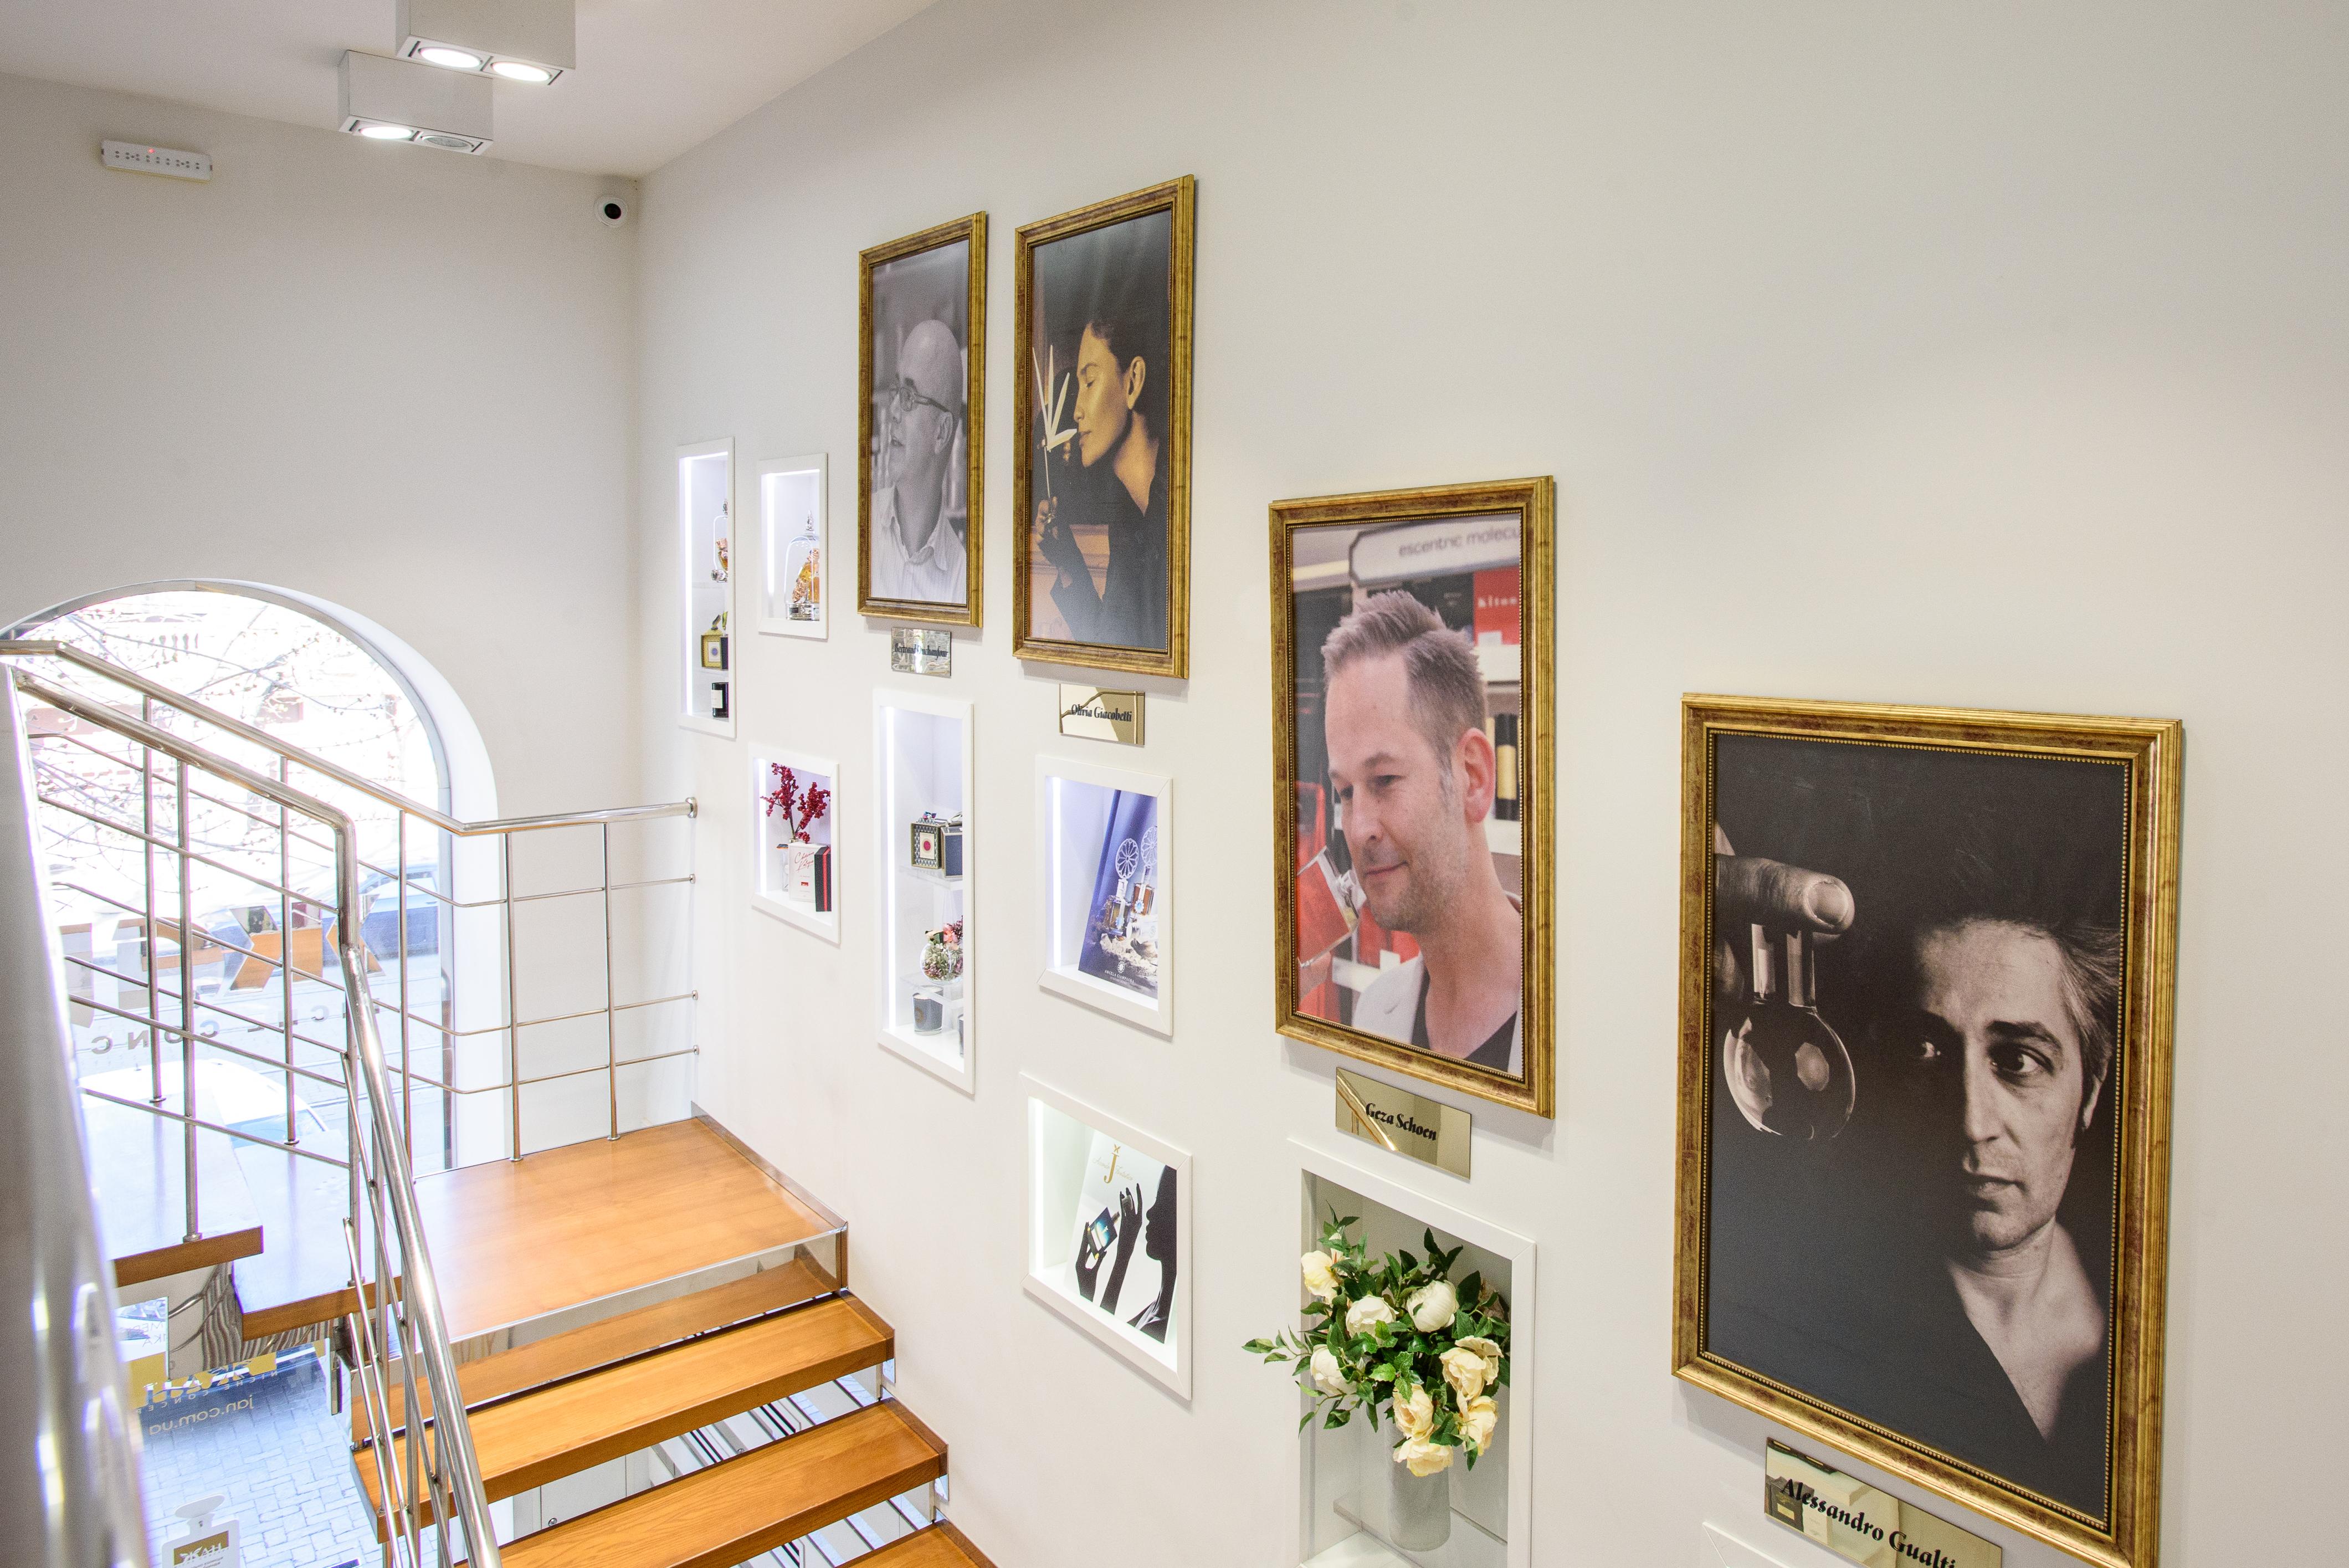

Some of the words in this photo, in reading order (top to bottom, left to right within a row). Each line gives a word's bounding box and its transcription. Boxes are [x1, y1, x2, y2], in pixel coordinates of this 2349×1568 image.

[1071, 704, 1093, 717] Olivia
[1094, 706, 1132, 722] Giacobetti
[1365, 1103, 1394, 1125] Geza
[1396, 1113, 1437, 1141] Schoen
[1781, 1478, 1884, 1541] Alessandro
